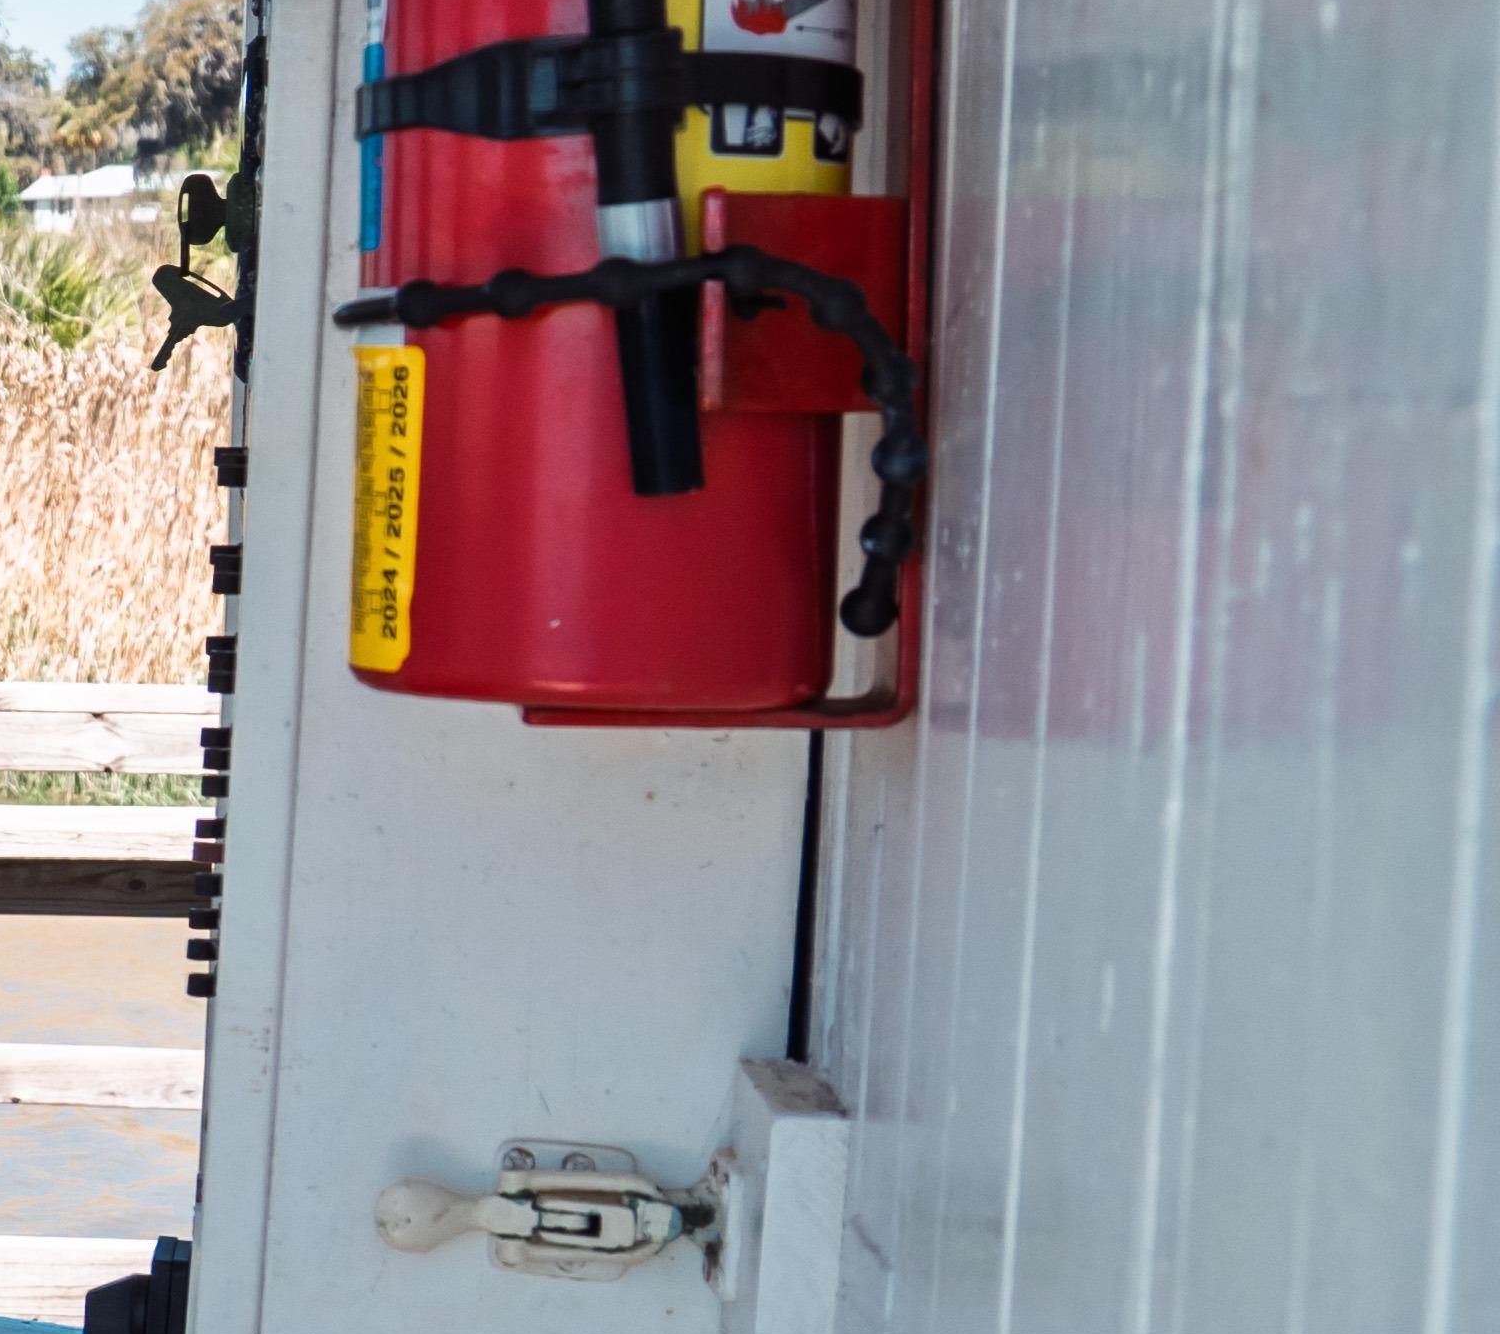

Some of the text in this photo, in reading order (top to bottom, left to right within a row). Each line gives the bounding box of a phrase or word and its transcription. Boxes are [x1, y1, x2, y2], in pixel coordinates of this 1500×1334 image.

[390, 365, 409, 437] 2026
[386, 467, 404, 538] 2025
[382, 569, 398, 640] 2024
